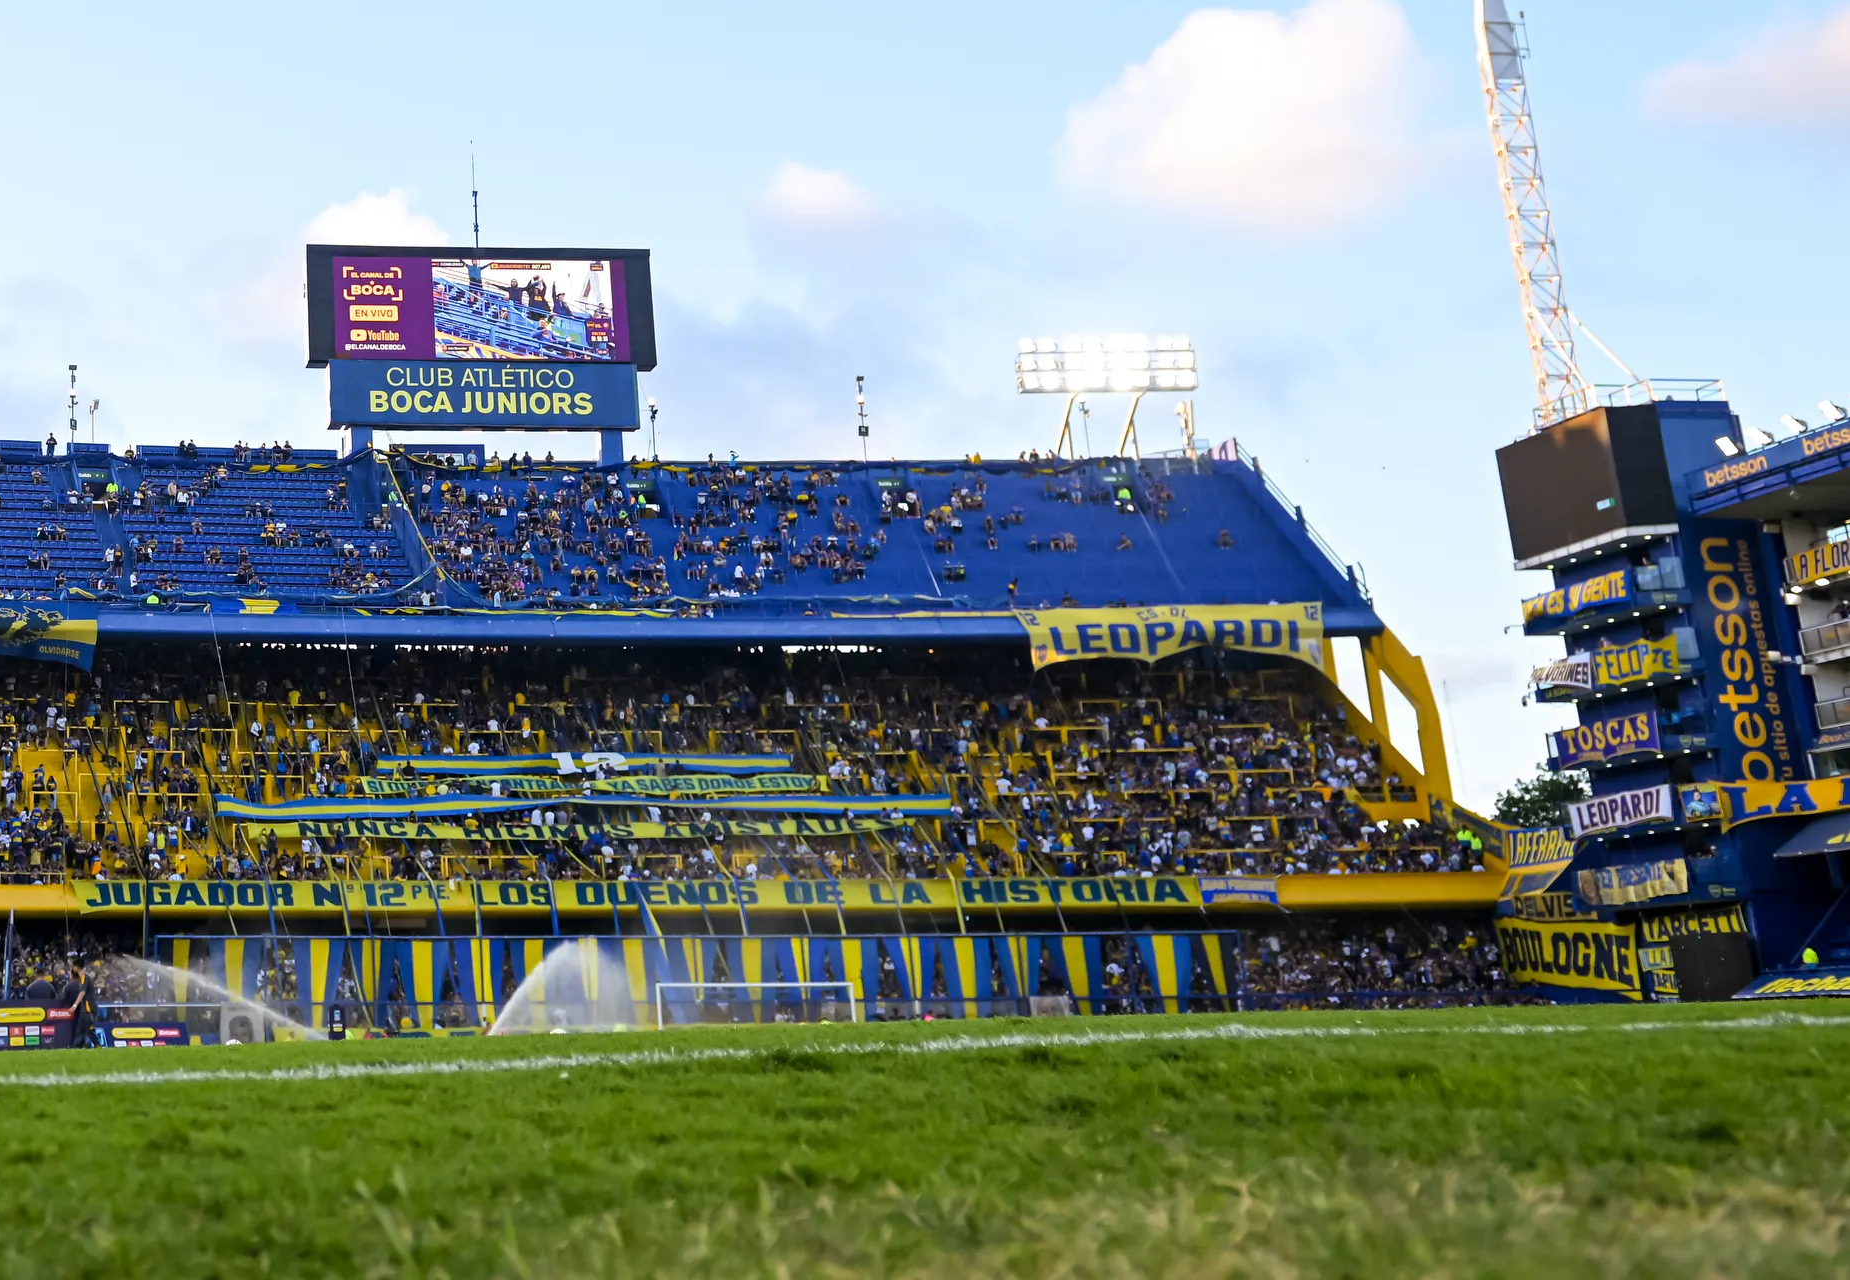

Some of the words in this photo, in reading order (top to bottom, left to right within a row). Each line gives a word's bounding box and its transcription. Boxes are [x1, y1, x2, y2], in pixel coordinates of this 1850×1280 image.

[351, 284, 395, 296] BOCA
[355, 309, 367, 317] EN
[370, 309, 393, 318] VIVO
[344, 343, 406, 351] @ELCANALDEBOCA
[367, 329, 400, 341] YouTube
[386, 367, 454, 387] CLUB
[461, 364, 575, 389] ATLÉTICO
[369, 389, 454, 413] BOCA
[461, 391, 594, 416] JUNIORS
[1704, 455, 1768, 487] betsson
[1736, 539, 1757, 595] online
[1582, 569, 1627, 604] GENTE
[1303, 604, 1320, 621] 12
[1050, 618, 1301, 657] LEOPARDI
[1748, 599, 1776, 687] apuestas
[38, 645, 81, 660] OLVIDARSE
[1700, 537, 1775, 784] betsson
[1765, 691, 1781, 716] de
[1562, 715, 1650, 755] TOSCAS
[1772, 720, 1791, 762] sitio
[551, 752, 629, 776] 12
[607, 778, 634, 793] YA
[639, 776, 697, 793] SABES
[699, 775, 756, 792] DONDE
[1575, 787, 1662, 832] LEOPARDI
[298, 820, 437, 838] NUNCA
[85, 880, 294, 907] JUGADOR
[362, 882, 407, 907] 12
[472, 881, 553, 906] LOS
[783, 881, 847, 906] DE
[869, 881, 933, 905] LA
[962, 878, 1190, 904] HISTORIA
[1500, 926, 1636, 989] BOULOGNE
